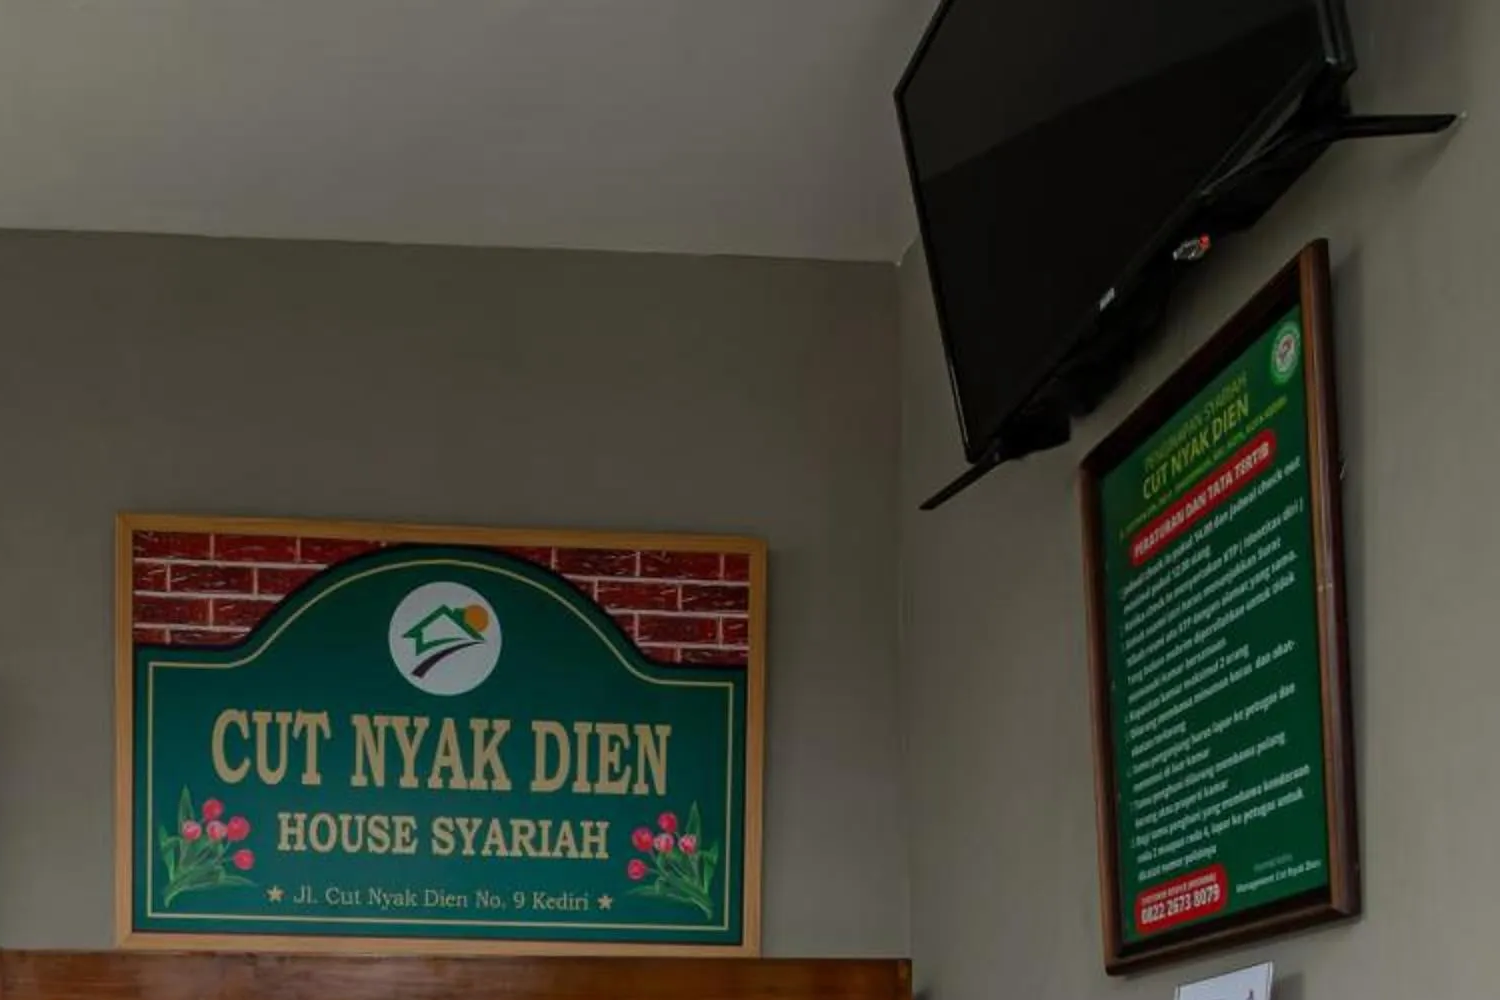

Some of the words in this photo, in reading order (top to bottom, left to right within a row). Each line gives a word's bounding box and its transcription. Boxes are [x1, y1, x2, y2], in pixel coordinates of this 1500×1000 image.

[1142, 460, 1168, 502] CUT
[1171, 425, 1209, 478] NYAK
[1211, 391, 1249, 444] DIEN
[1134, 505, 1185, 560] PERATURAN
[1185, 489, 1206, 520] DAN
[1207, 468, 1232, 503] TATA
[1234, 438, 1269, 481] TERTIB
[211, 708, 330, 787] CUT
[350, 713, 512, 791] NYAK
[530, 720, 671, 795] DIEN
[277, 812, 418, 854] HOUSE
[431, 816, 610, 860] SYARIAH
[293, 886, 316, 905] Jl.
[325, 888, 360, 906] Cut
[367, 887, 418, 911] Nyak
[424, 889, 468, 909] Dien
[476, 891, 506, 909] No.
[514, 891, 525, 909] 9
[531, 892, 589, 911] Kediri
